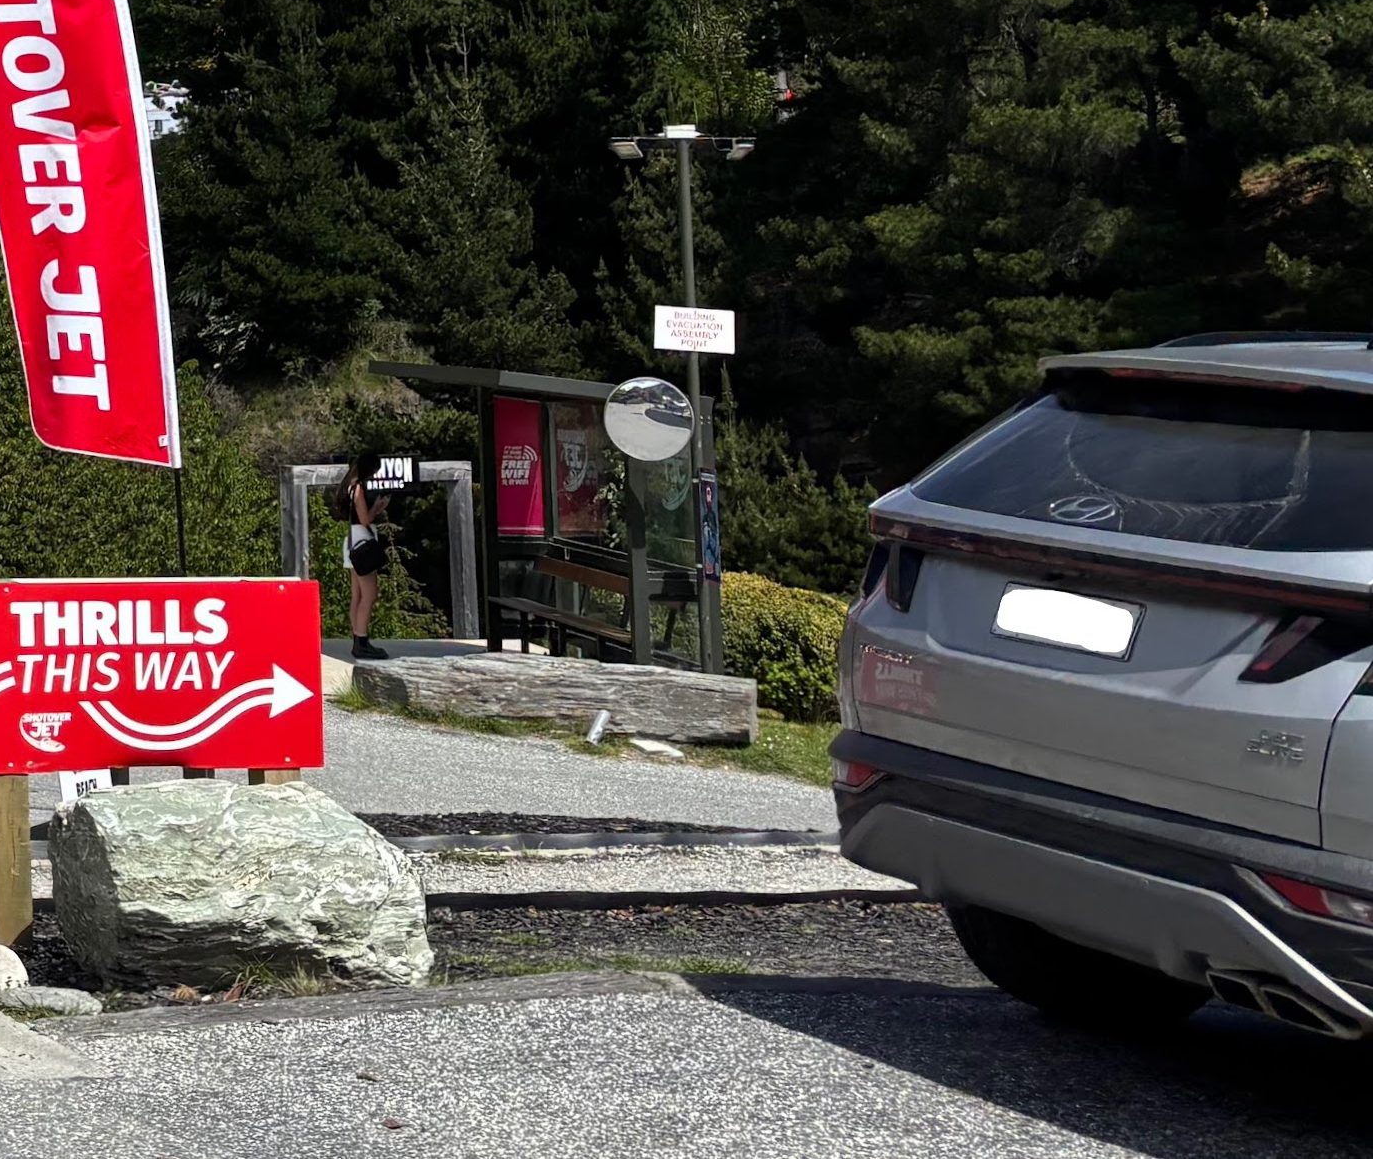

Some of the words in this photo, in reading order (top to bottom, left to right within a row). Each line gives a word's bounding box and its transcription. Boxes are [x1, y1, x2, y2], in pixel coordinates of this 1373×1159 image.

[40, 258, 111, 411] JET
[501, 460, 531, 469] FREE
[501, 469, 530, 479] WIFI
[10, 597, 229, 648] THRILLS
[17, 652, 121, 694] THIS
[134, 650, 235, 691] WAY
[22, 712, 72, 723] SHOTOVER
[29, 721, 63, 738] JET
